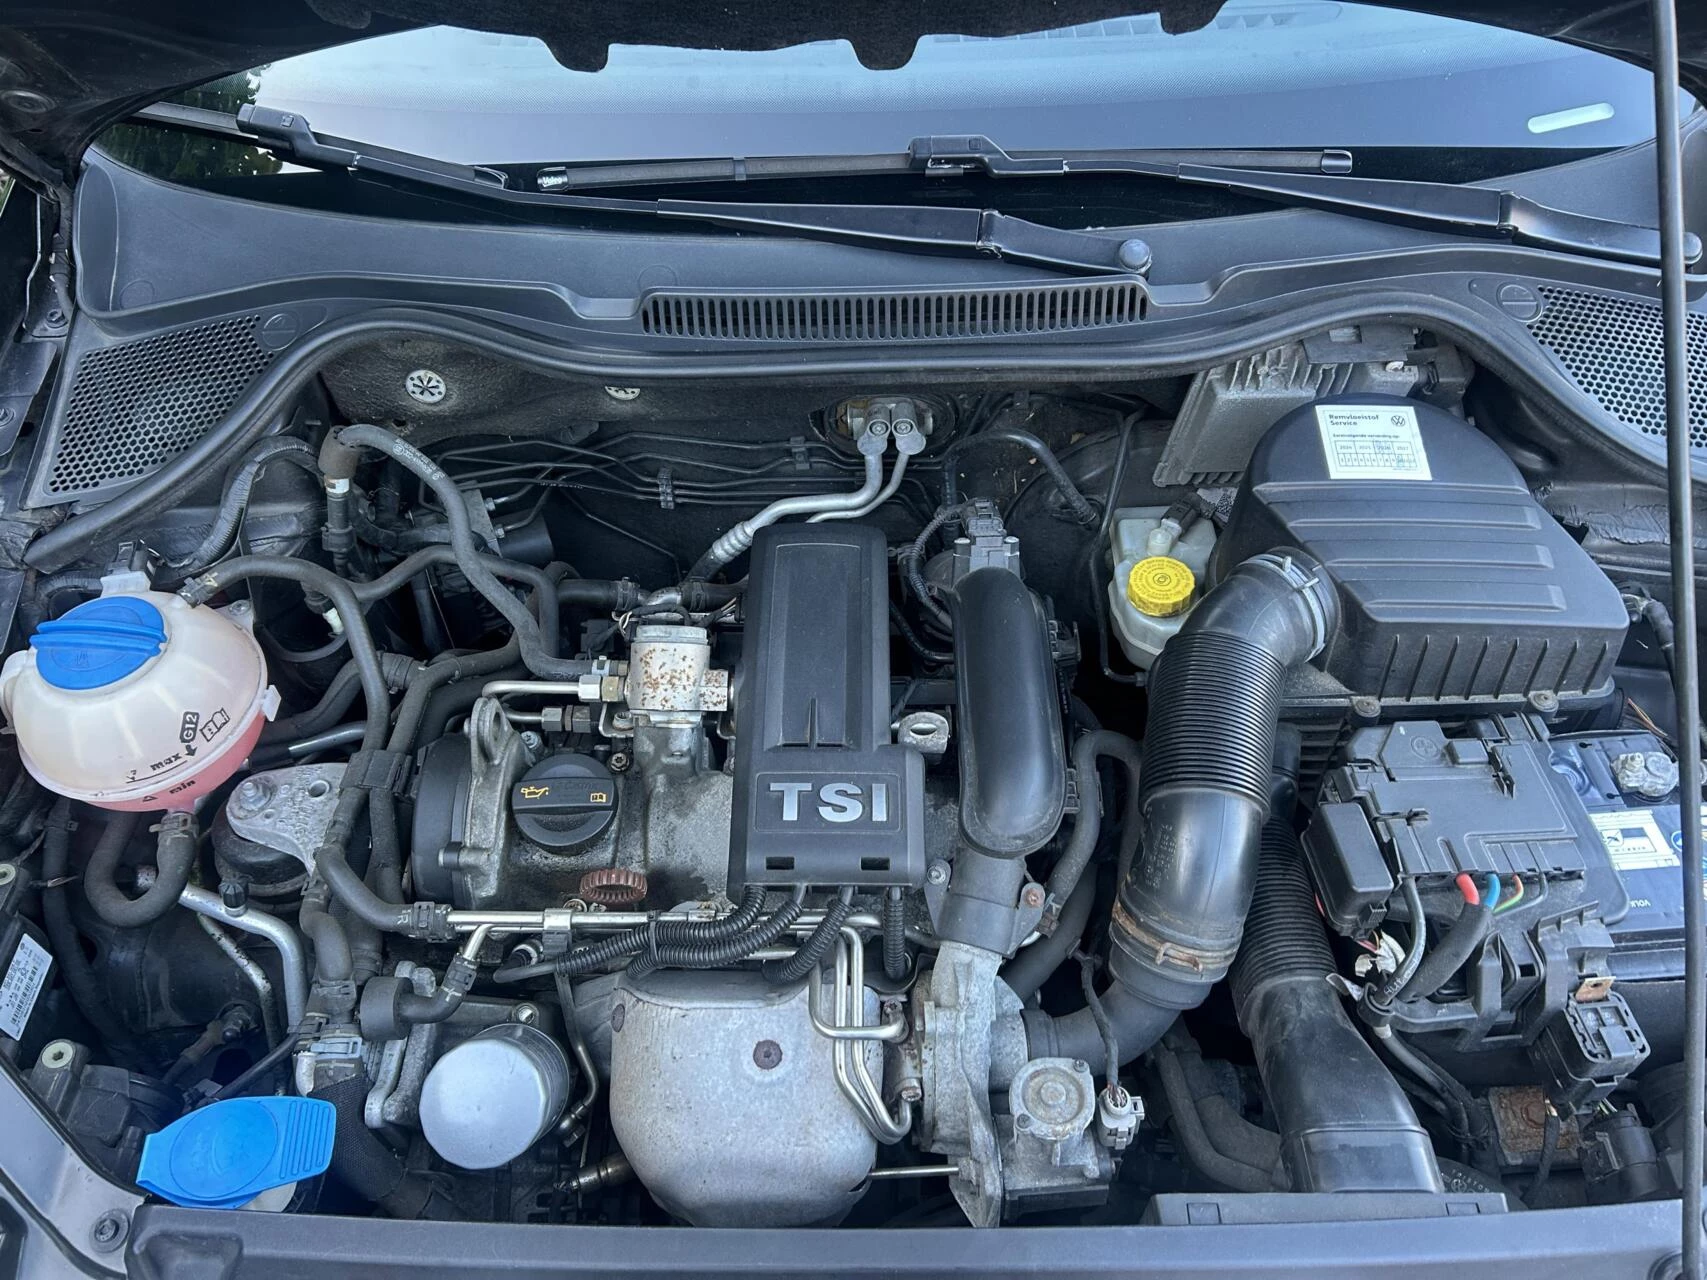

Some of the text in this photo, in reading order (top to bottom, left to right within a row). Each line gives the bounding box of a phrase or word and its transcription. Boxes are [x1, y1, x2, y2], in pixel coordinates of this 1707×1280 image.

[183, 712, 198, 739] G12
[150, 752, 183, 772] max
[169, 780, 196, 795] min
[769, 782, 888, 823] TSI
